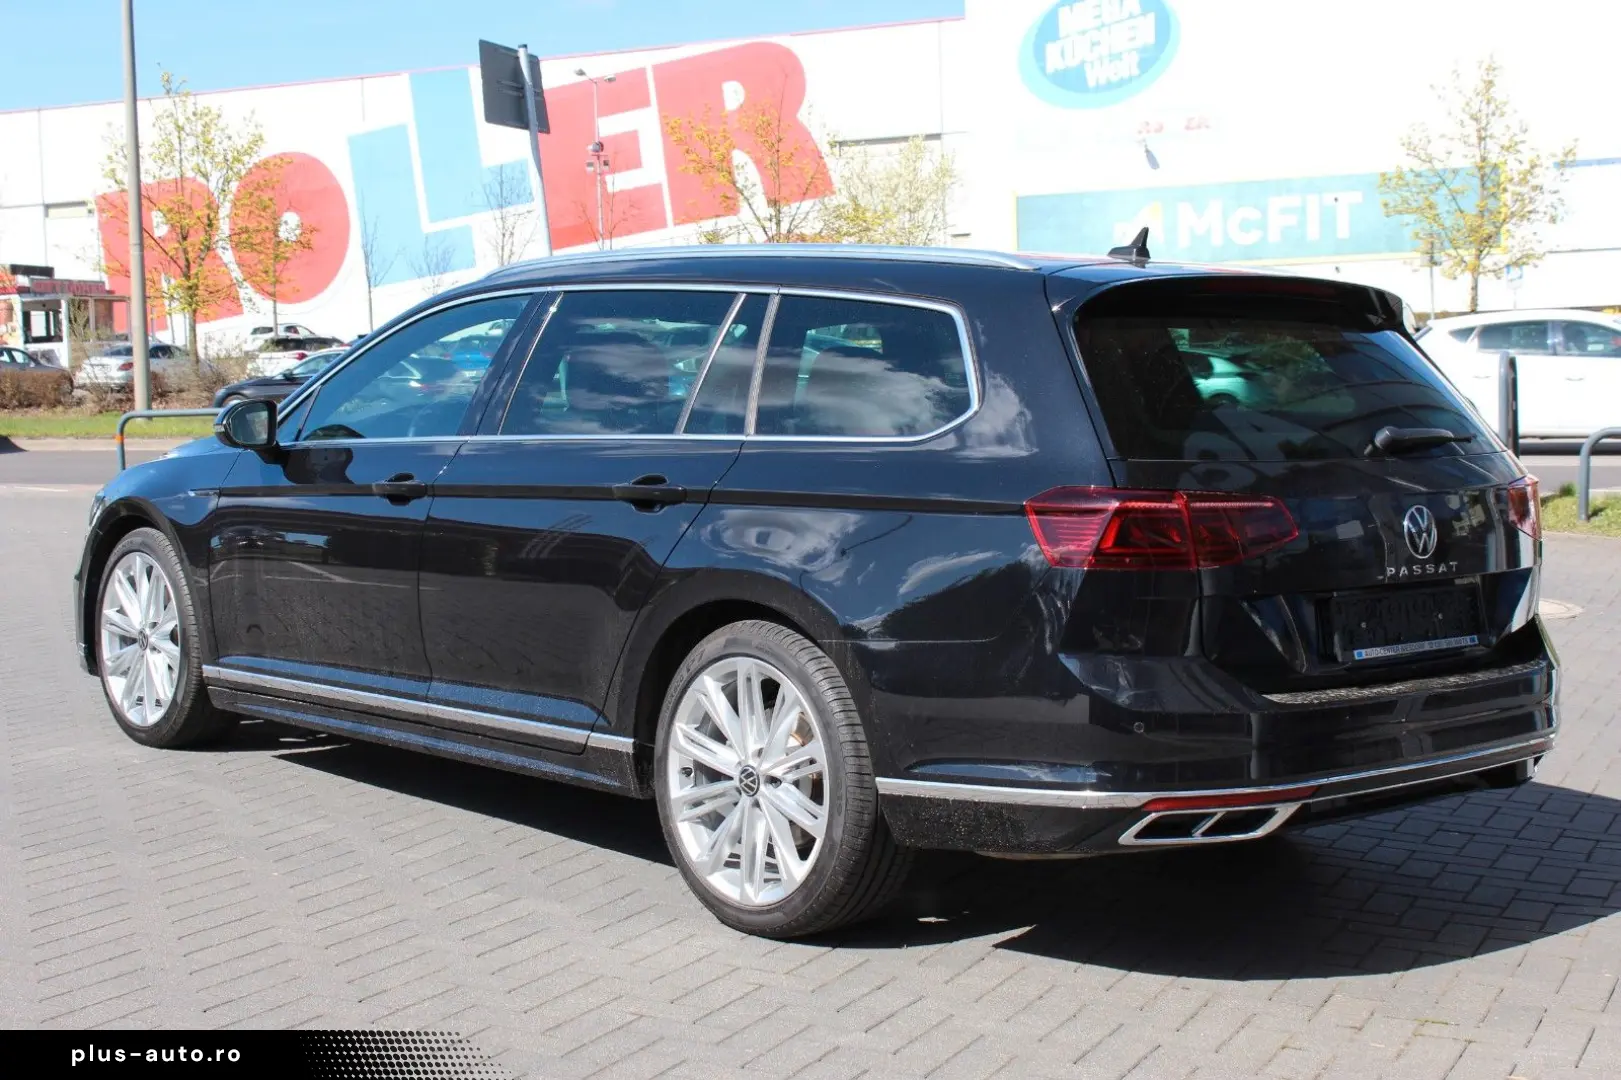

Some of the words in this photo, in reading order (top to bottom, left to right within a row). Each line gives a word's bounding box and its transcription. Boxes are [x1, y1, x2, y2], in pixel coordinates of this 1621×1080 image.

[96, 42, 834, 332] ROLLER
[1177, 191, 1362, 248] McFIT
[1386, 561, 1458, 577] PASSAT
